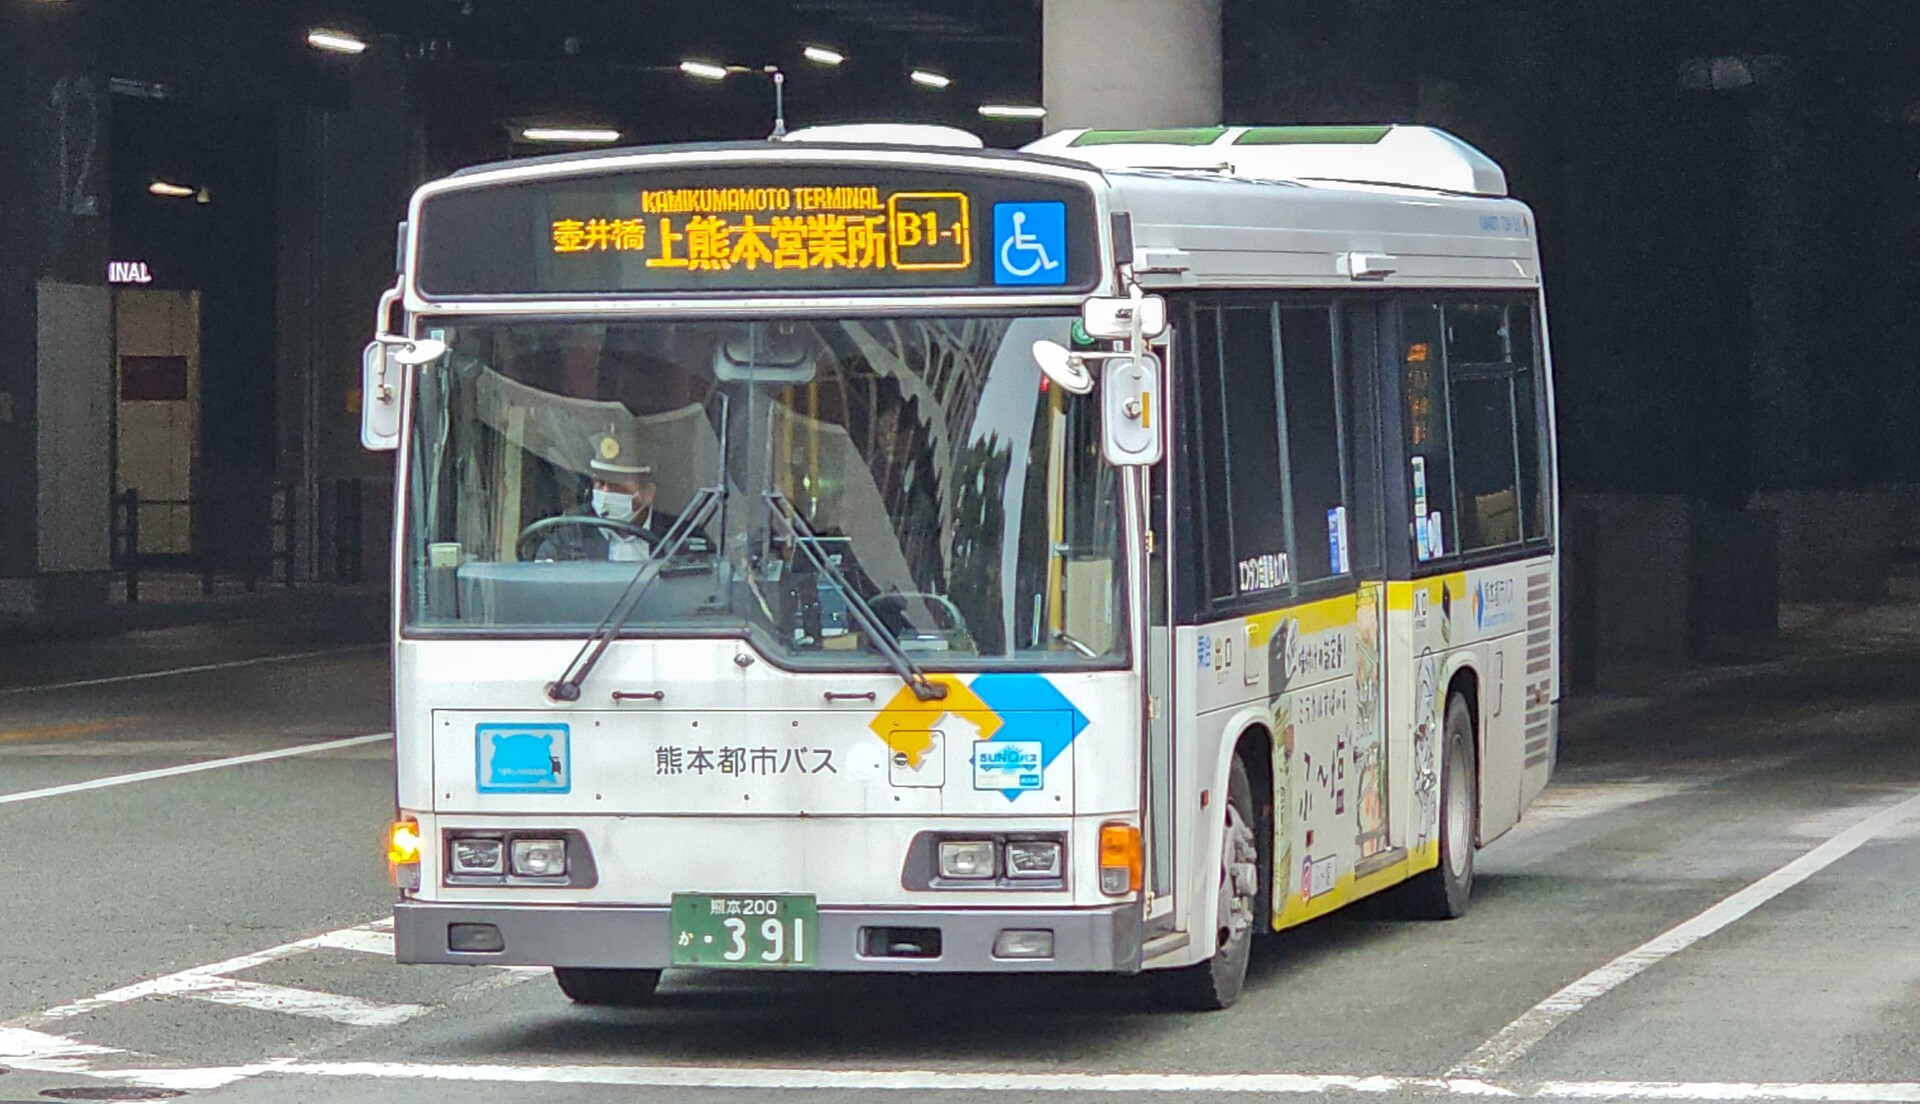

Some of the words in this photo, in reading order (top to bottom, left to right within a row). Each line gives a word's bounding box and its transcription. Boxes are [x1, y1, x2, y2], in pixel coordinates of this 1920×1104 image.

[641, 188, 790, 213] KAMIKUMAMOTO
[793, 186, 885, 210] TERMINAL
[645, 213, 887, 271] 上熊本営業所
[897, 211, 962, 246] B1-1
[656, 746, 838, 777] 熊本都市バス
